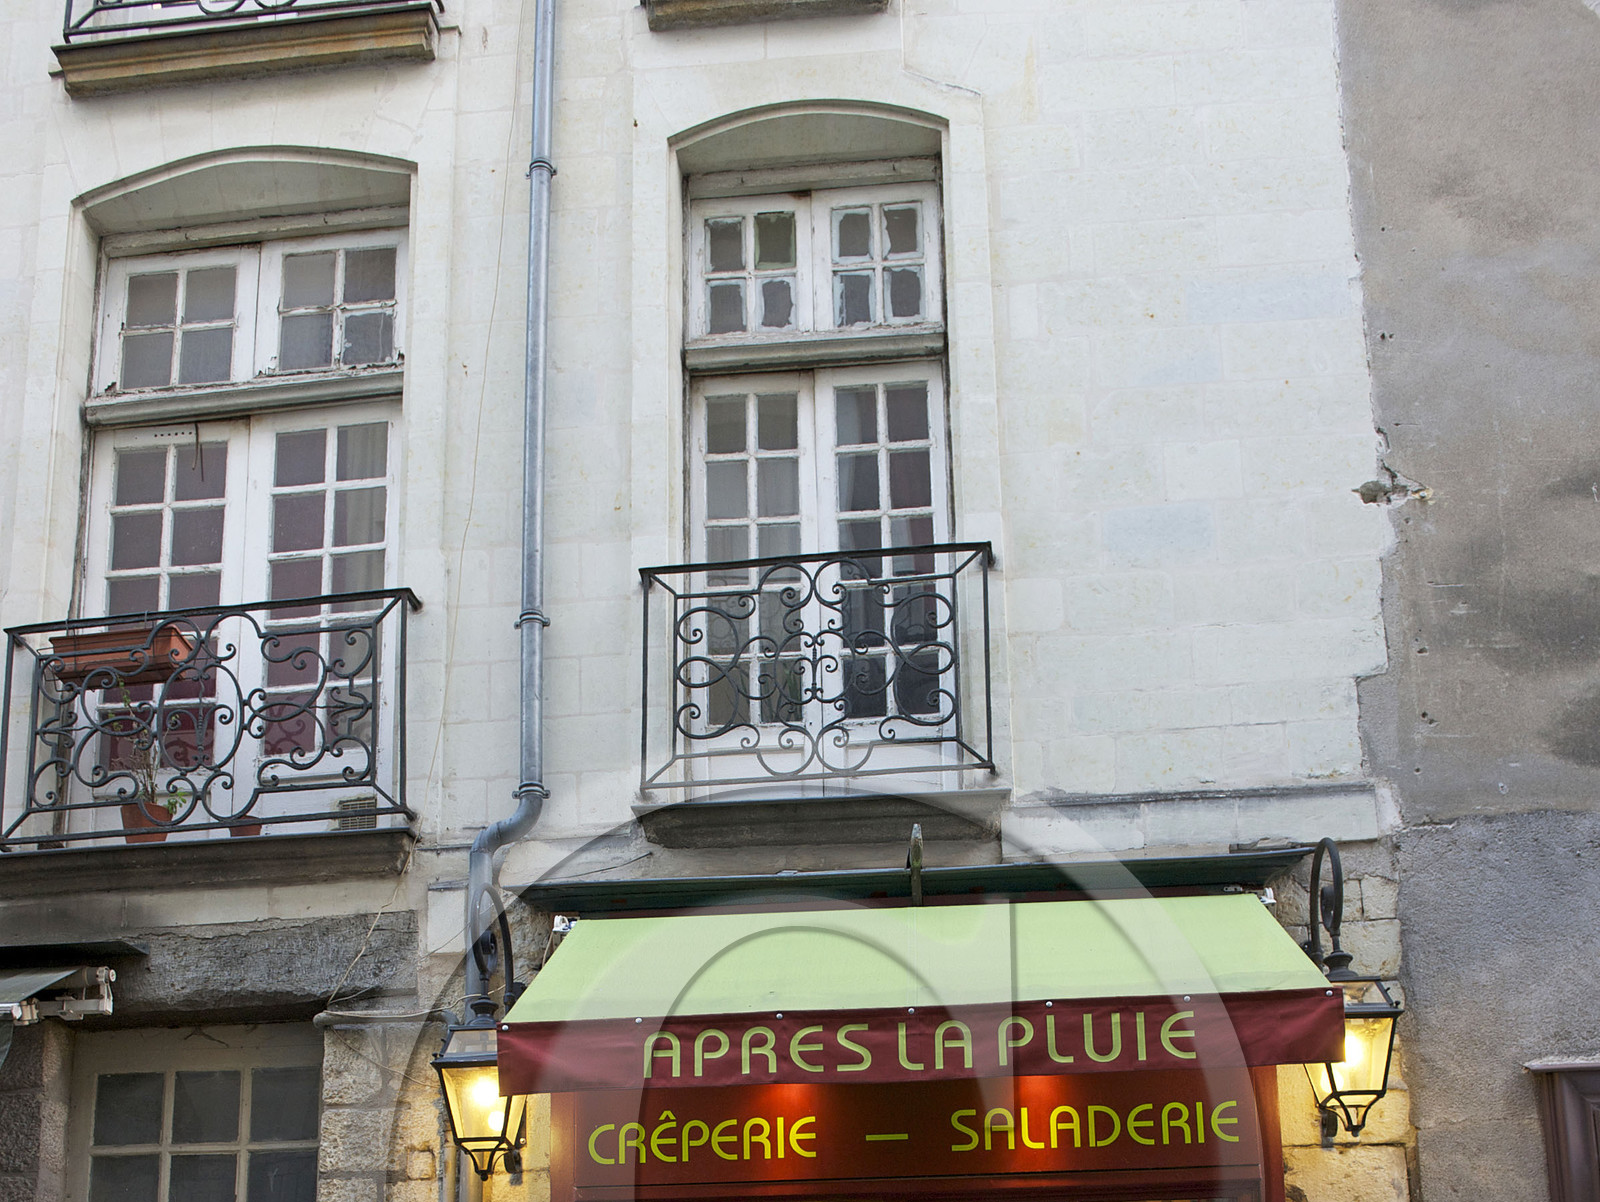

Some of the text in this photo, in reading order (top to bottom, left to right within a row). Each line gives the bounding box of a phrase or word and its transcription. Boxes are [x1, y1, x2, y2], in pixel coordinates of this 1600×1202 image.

[643, 1010, 1199, 1079] APRES LA PLUIE
[587, 1100, 1240, 1166] CRÊPERIE SALADERIE
